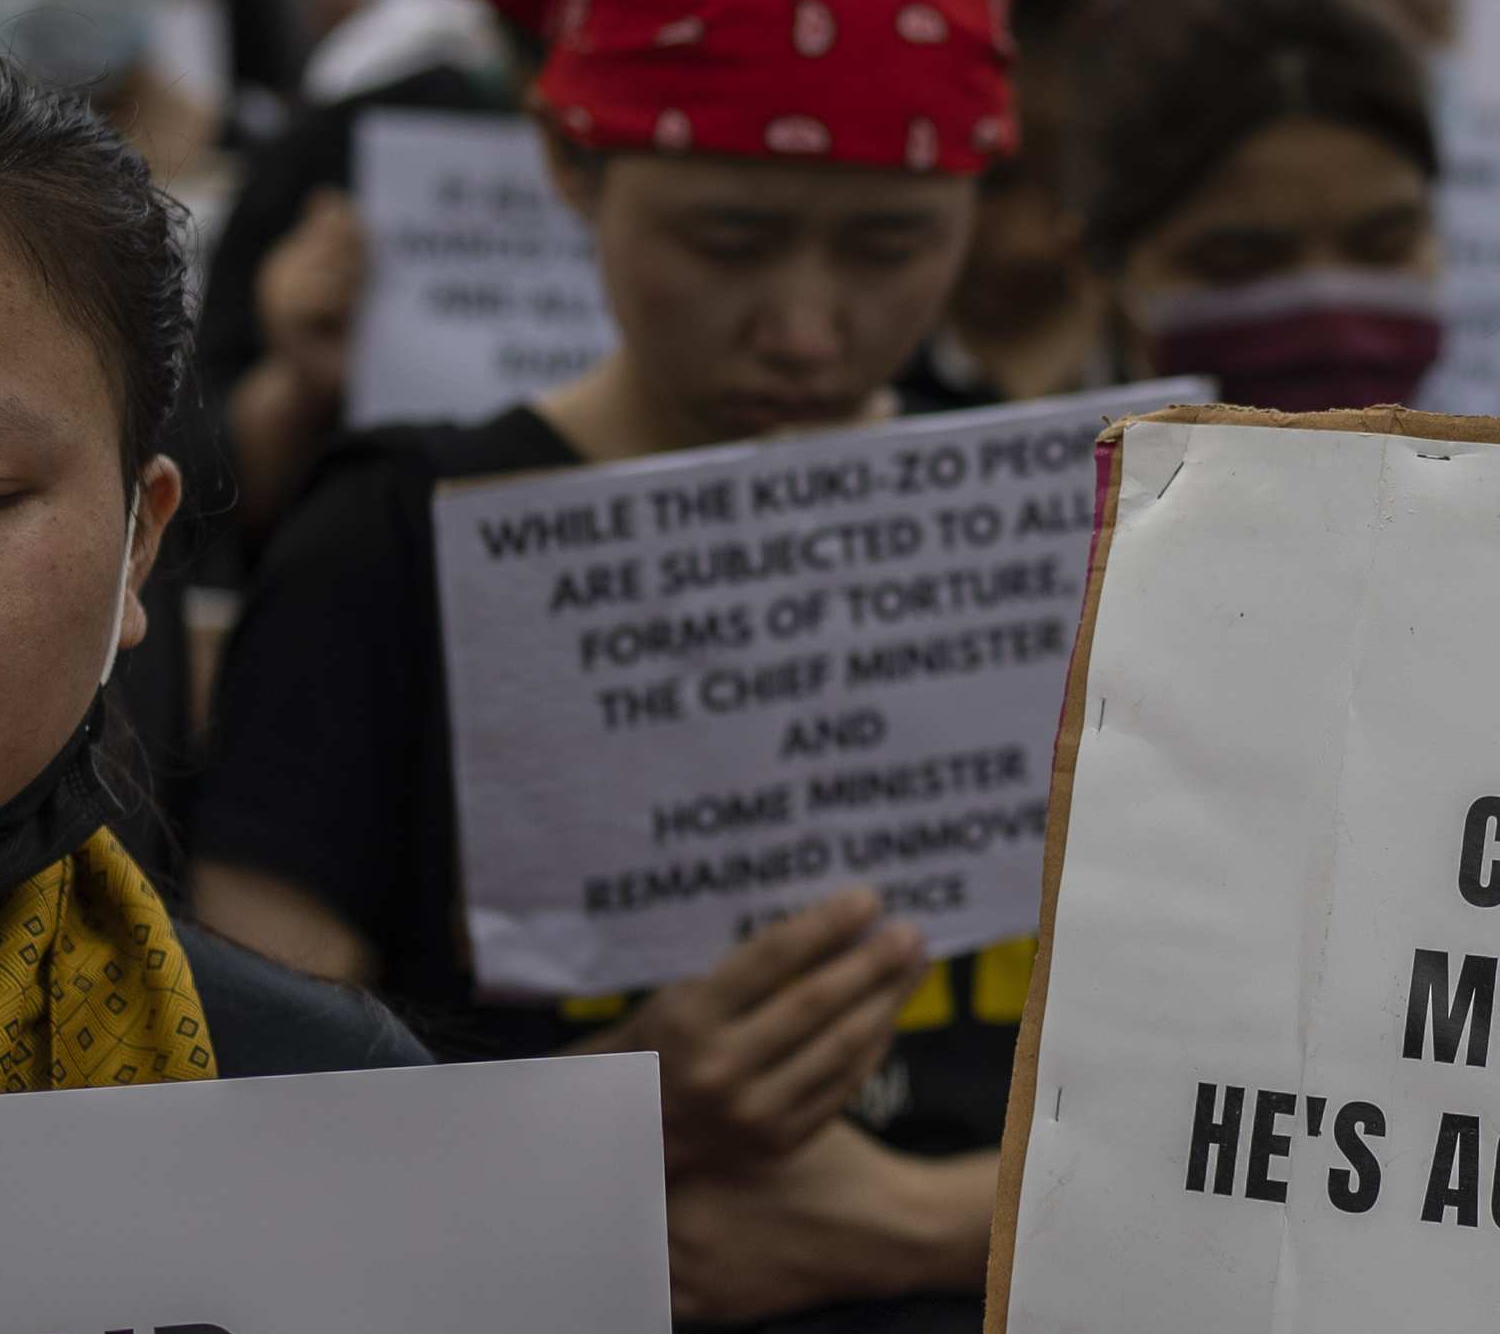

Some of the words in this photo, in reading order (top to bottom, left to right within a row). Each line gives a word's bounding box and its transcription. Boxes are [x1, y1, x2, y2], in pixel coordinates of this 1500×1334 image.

[480, 495, 633, 561] WHILE
[648, 478, 736, 531] THE
[752, 445, 968, 517] KUKI-ZO
[551, 558, 643, 612] ARE
[660, 517, 922, 595] SUBJECTED
[937, 506, 1001, 549] TO
[1013, 491, 1097, 535] ALL
[580, 610, 753, 668] FORMS
[767, 591, 823, 641] OF
[599, 681, 684, 731] THE
[700, 653, 830, 713] CHIEF
[846, 618, 1067, 685] MINISTER
[780, 707, 886, 759] AND
[654, 784, 792, 845] HOME
[805, 745, 1030, 810] MINISTER
[585, 838, 832, 916] REMAINED
[1186, 1082, 1385, 1213] HE'S
